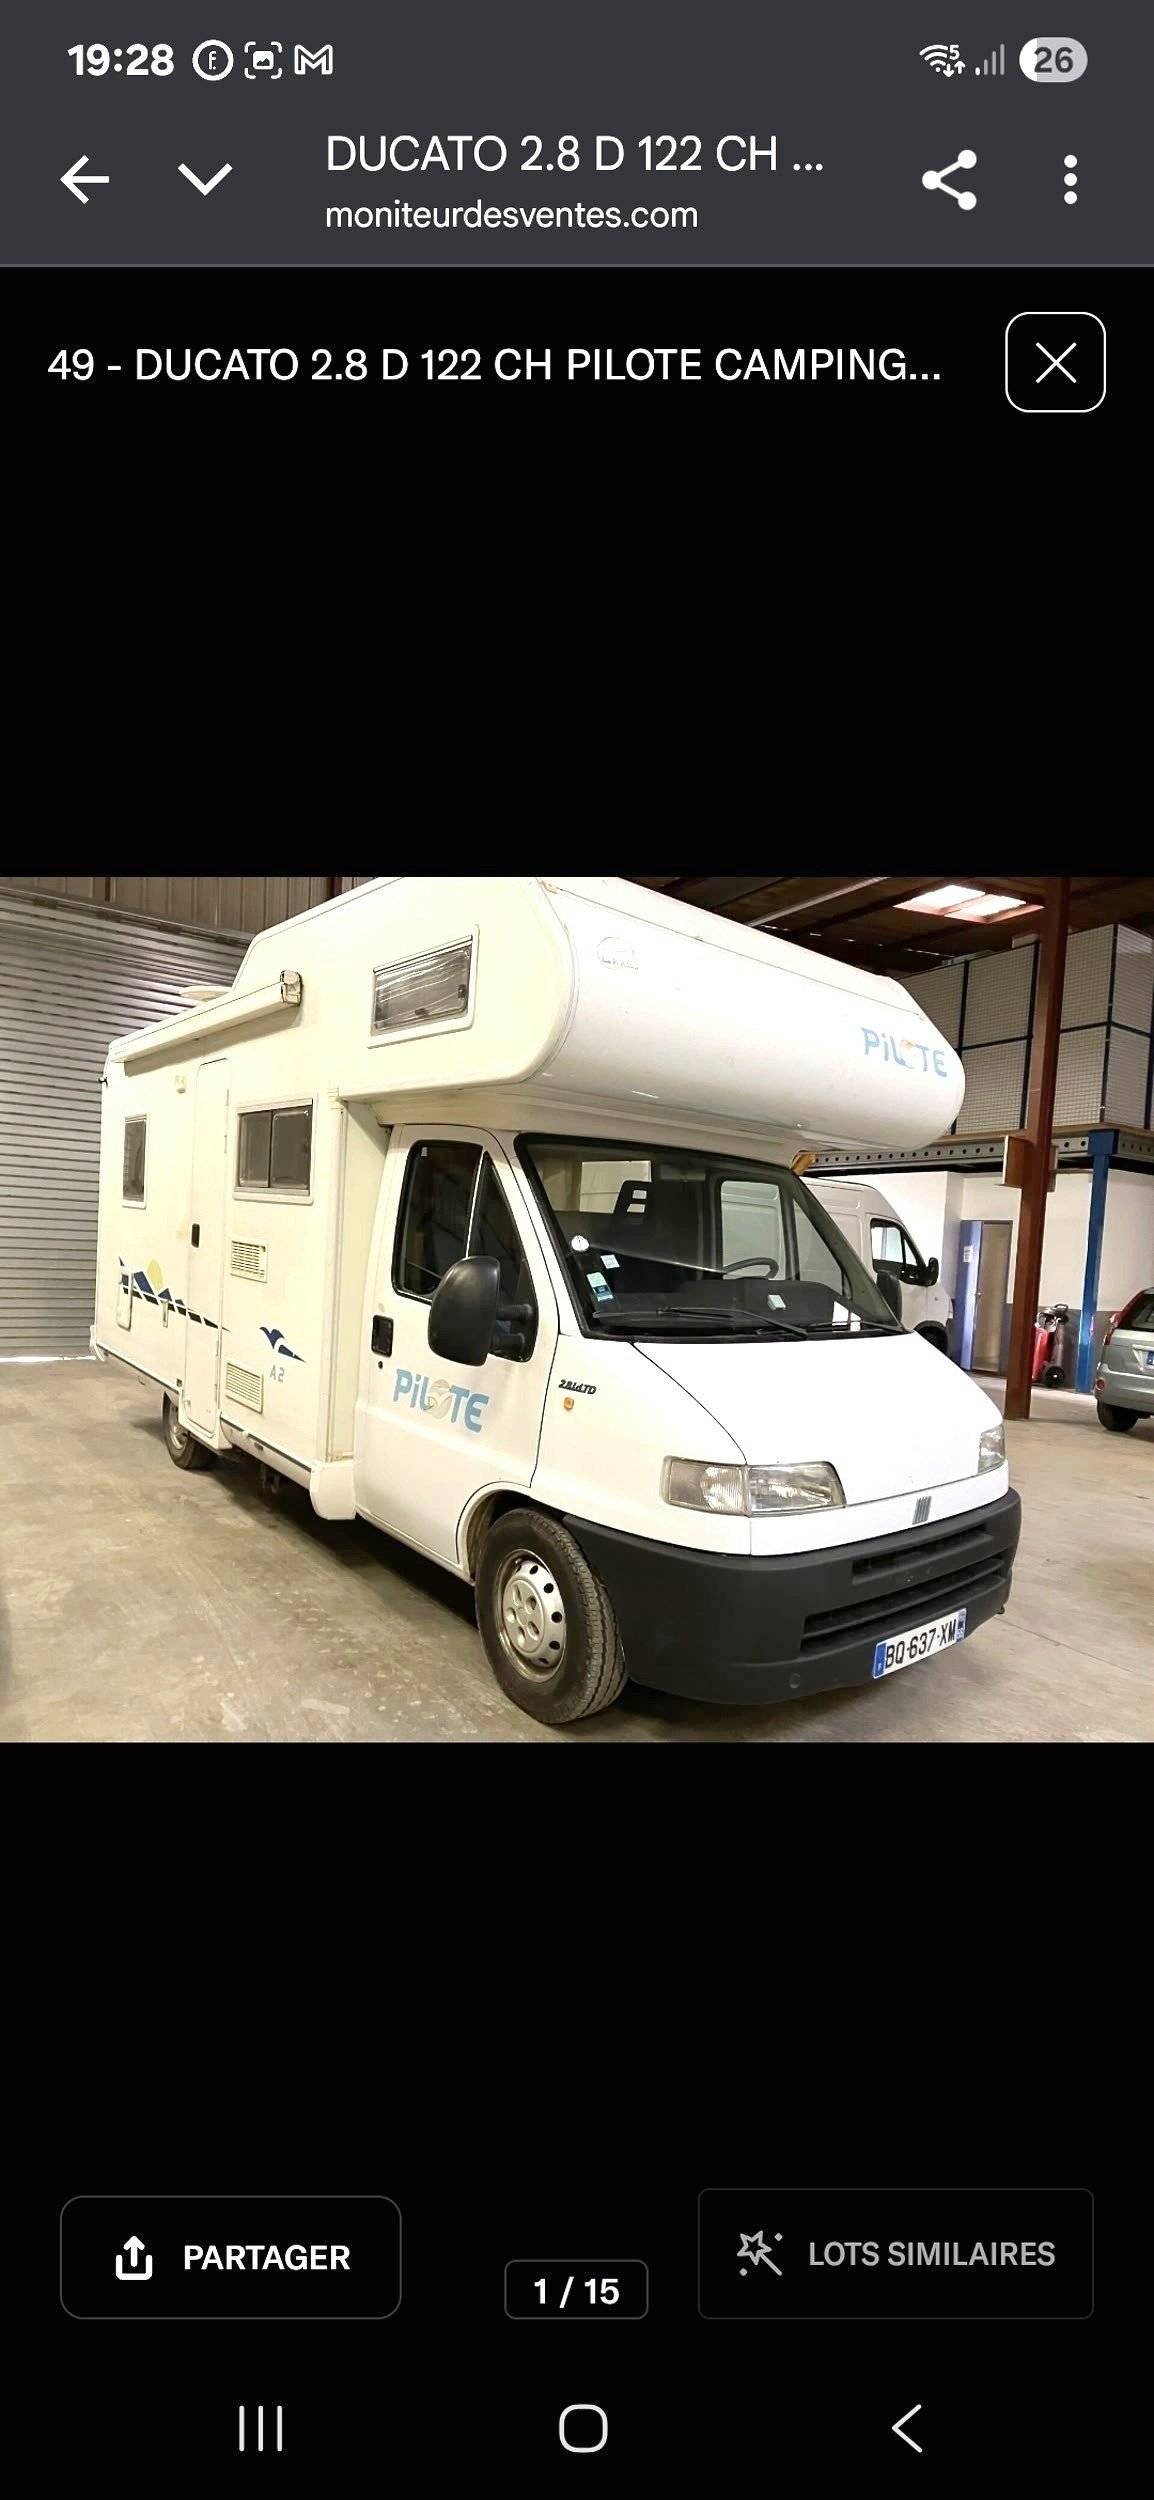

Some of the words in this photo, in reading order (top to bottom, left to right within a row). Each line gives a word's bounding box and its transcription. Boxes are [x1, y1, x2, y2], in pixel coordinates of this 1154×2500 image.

[67, 42, 175, 77] 19:28
[1033, 46, 1074, 74] 26
[327, 135, 508, 172] DUCATO
[520, 135, 581, 172] 2.8
[595, 136, 625, 171] D
[635, 135, 702, 172] 122
[717, 135, 777, 172] CH
[326, 200, 698, 230] moniteurdesventes.com
[47, 349, 95, 382] 49
[135, 348, 299, 382] DUCATO
[311, 349, 368, 382] 2.8
[383, 349, 409, 381] D
[420, 349, 482, 381] 122
[494, 348, 552, 382] CH
[567, 348, 702, 382] PILOTE
[715, 348, 941, 382] CAMPING...
[183, 2244, 351, 2272] PARTAGER
[809, 2240, 880, 2268] LOTS
[887, 2240, 1056, 2268] SIMILAIRES
[533, 2277, 547, 2305] 1
[558, 2275, 575, 2309] /
[583, 2277, 620, 2306] 15
